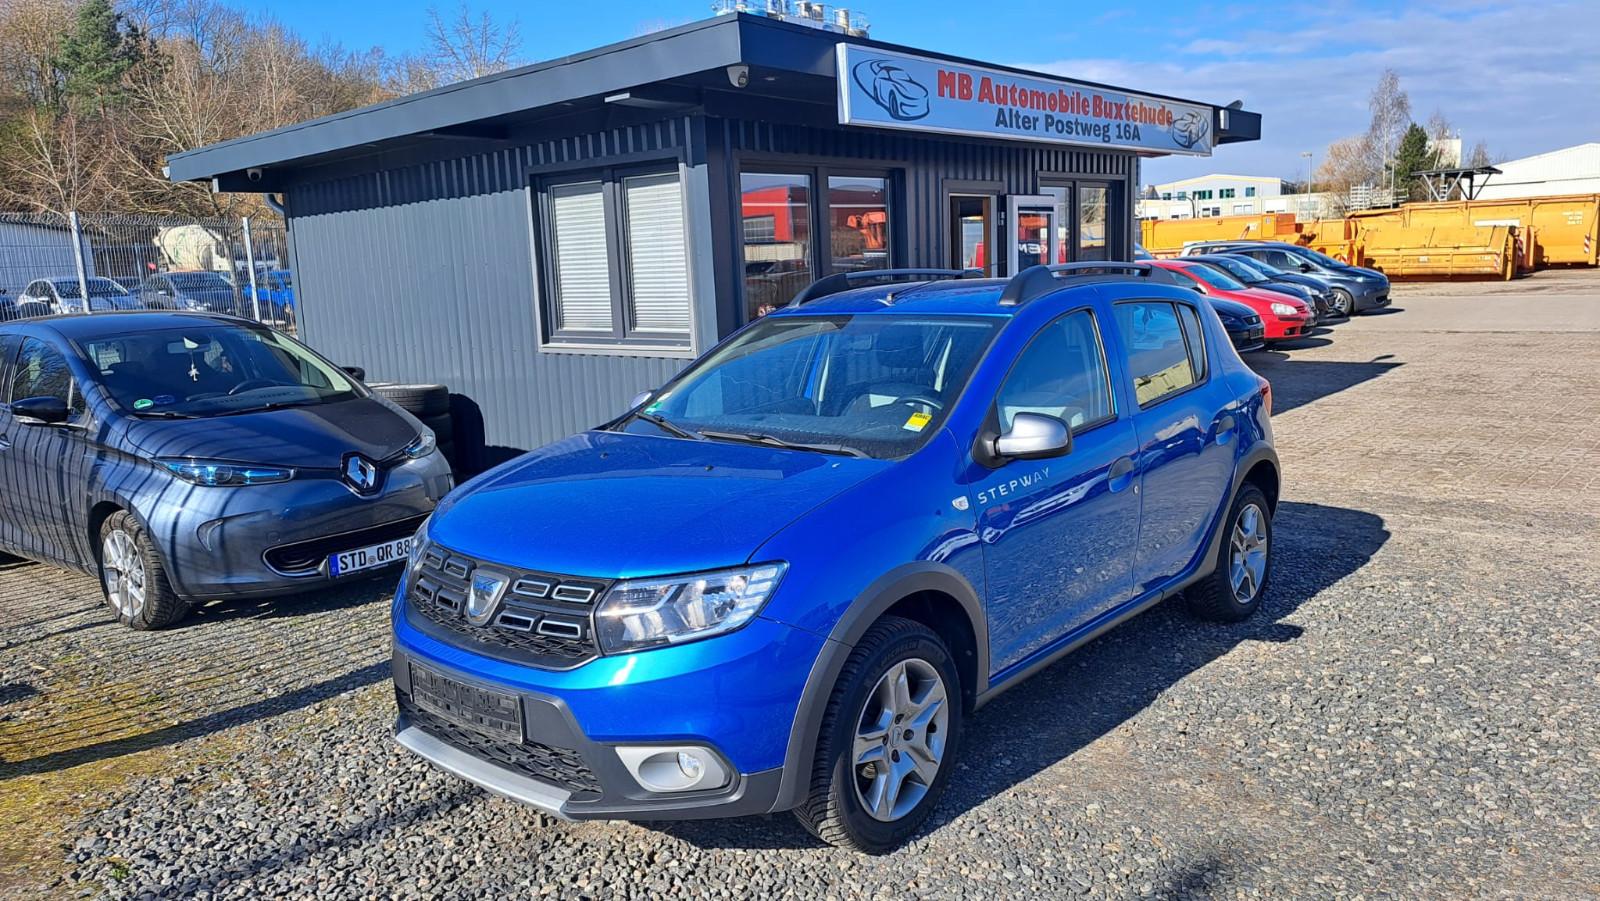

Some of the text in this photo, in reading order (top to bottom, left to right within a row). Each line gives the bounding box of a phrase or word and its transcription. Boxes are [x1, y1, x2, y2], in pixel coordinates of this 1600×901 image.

[937, 69, 1173, 126] MB Automobile Buxtehude
[995, 107, 1141, 143] Alter Postweg 16A
[977, 466, 1050, 504] STEPWAY
[340, 538, 413, 571] STD QR 88
